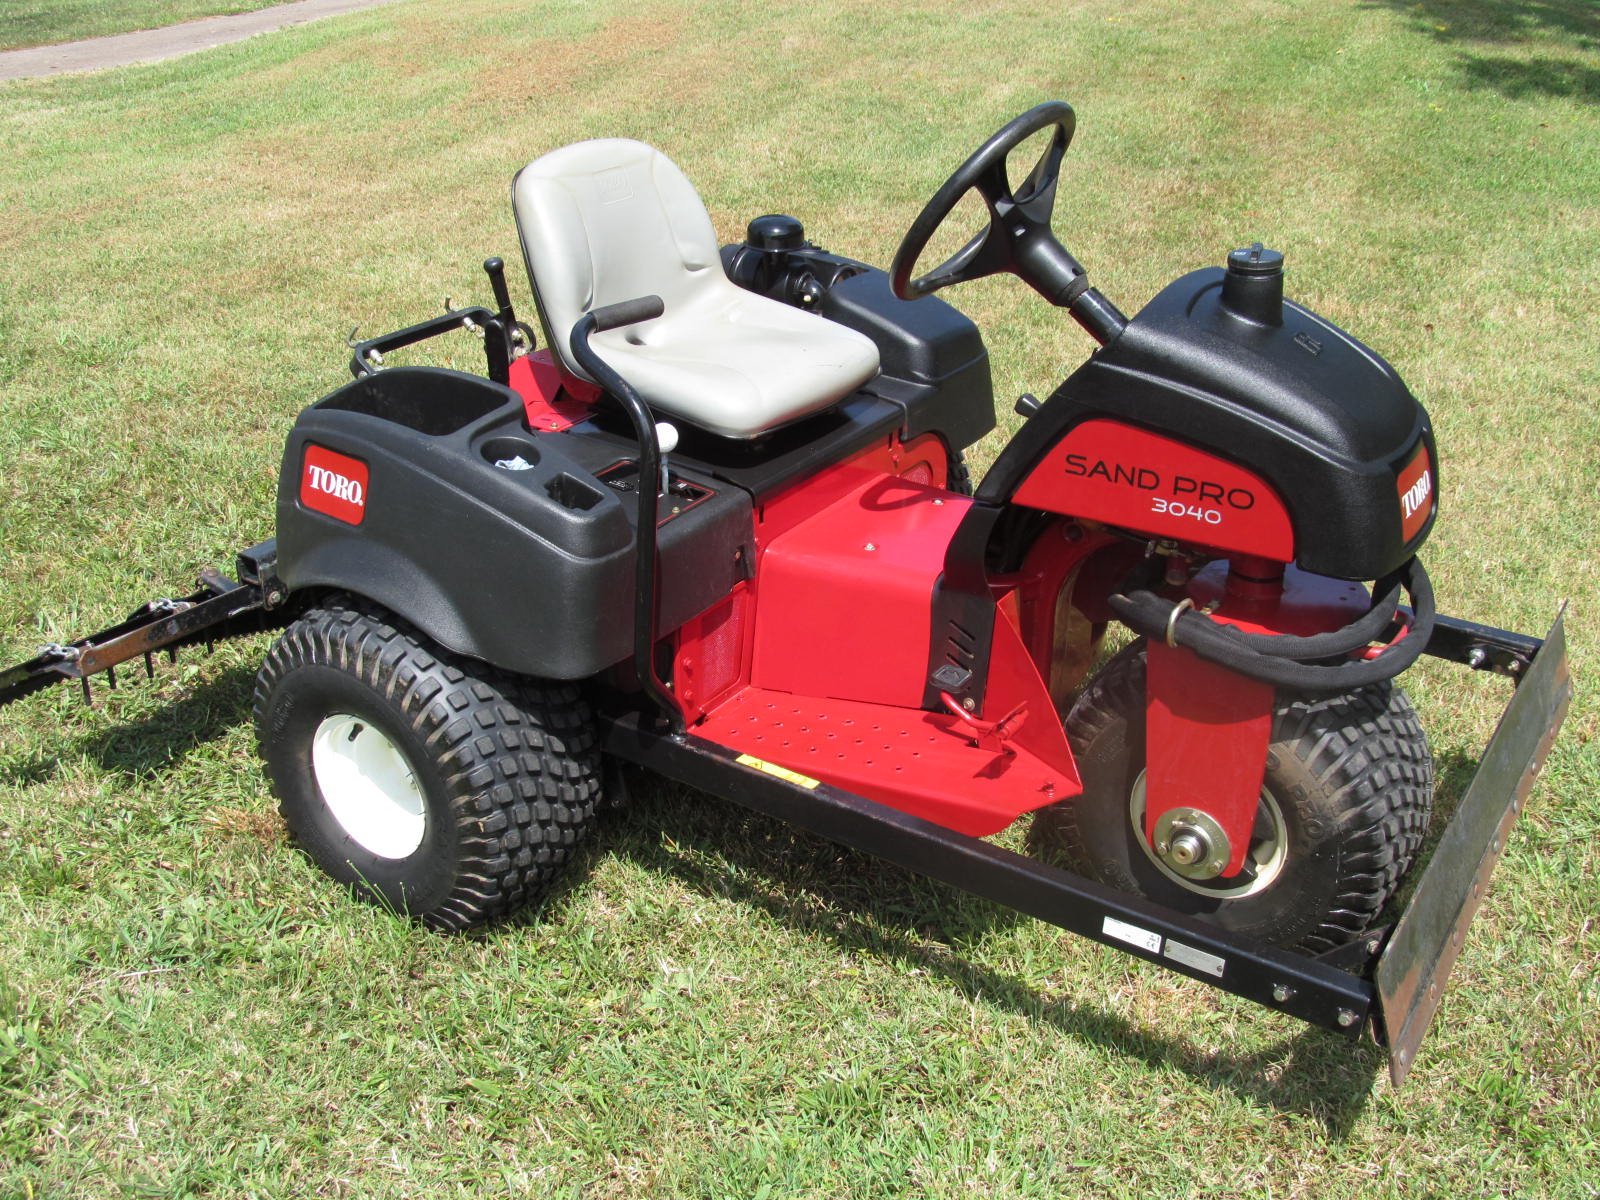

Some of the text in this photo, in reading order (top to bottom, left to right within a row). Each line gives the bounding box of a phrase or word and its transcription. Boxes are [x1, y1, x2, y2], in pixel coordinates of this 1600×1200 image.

[309, 465, 363, 505] TORO
[1065, 454, 1255, 511] SAND PRO
[1402, 470, 1431, 519] TORO
[1151, 497, 1222, 525] 3040
